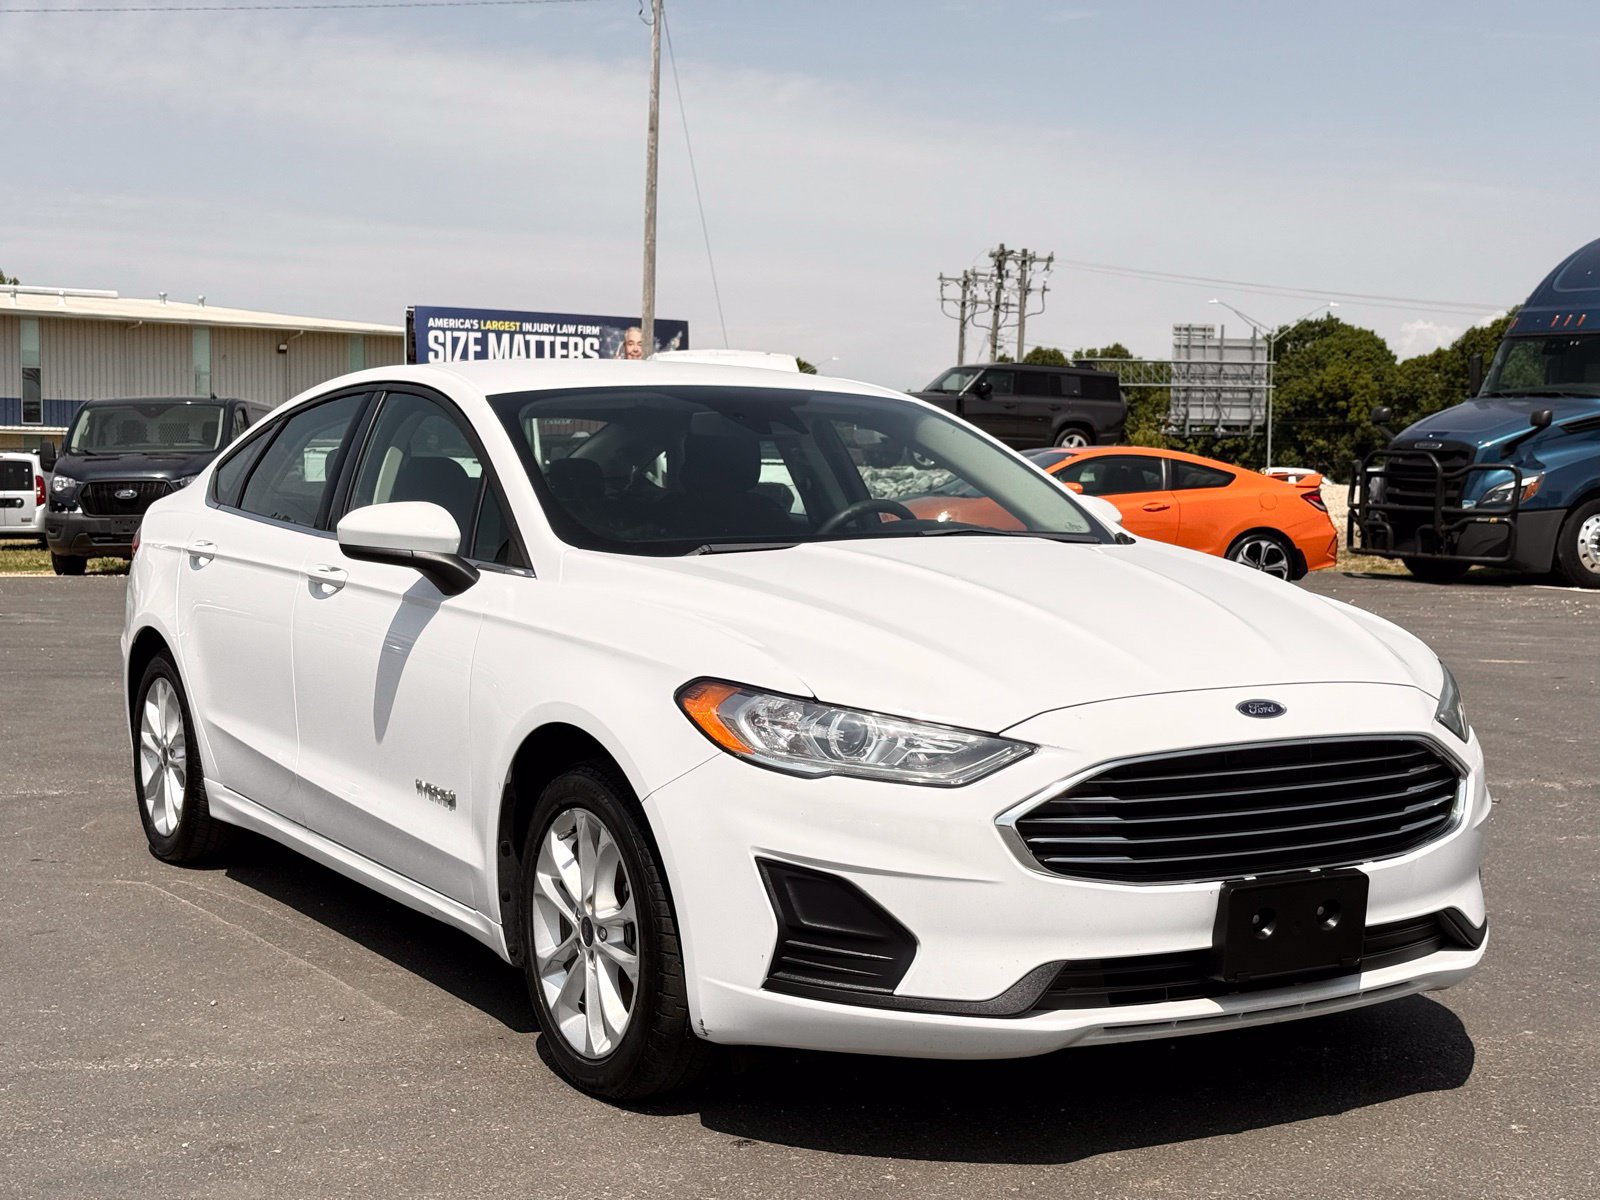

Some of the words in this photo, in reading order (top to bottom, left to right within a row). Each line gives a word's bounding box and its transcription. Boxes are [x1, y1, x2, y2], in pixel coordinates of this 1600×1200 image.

[428, 317, 479, 329] AMERICA'S
[480, 319, 521, 331] LARGEST
[522, 322, 556, 333] INJURY
[557, 324, 576, 334] LAW
[577, 325, 600, 335] FIRM
[428, 330, 482, 361] SIZE
[488, 332, 600, 360] MATTERS
[1248, 702, 1277, 714] Ford
